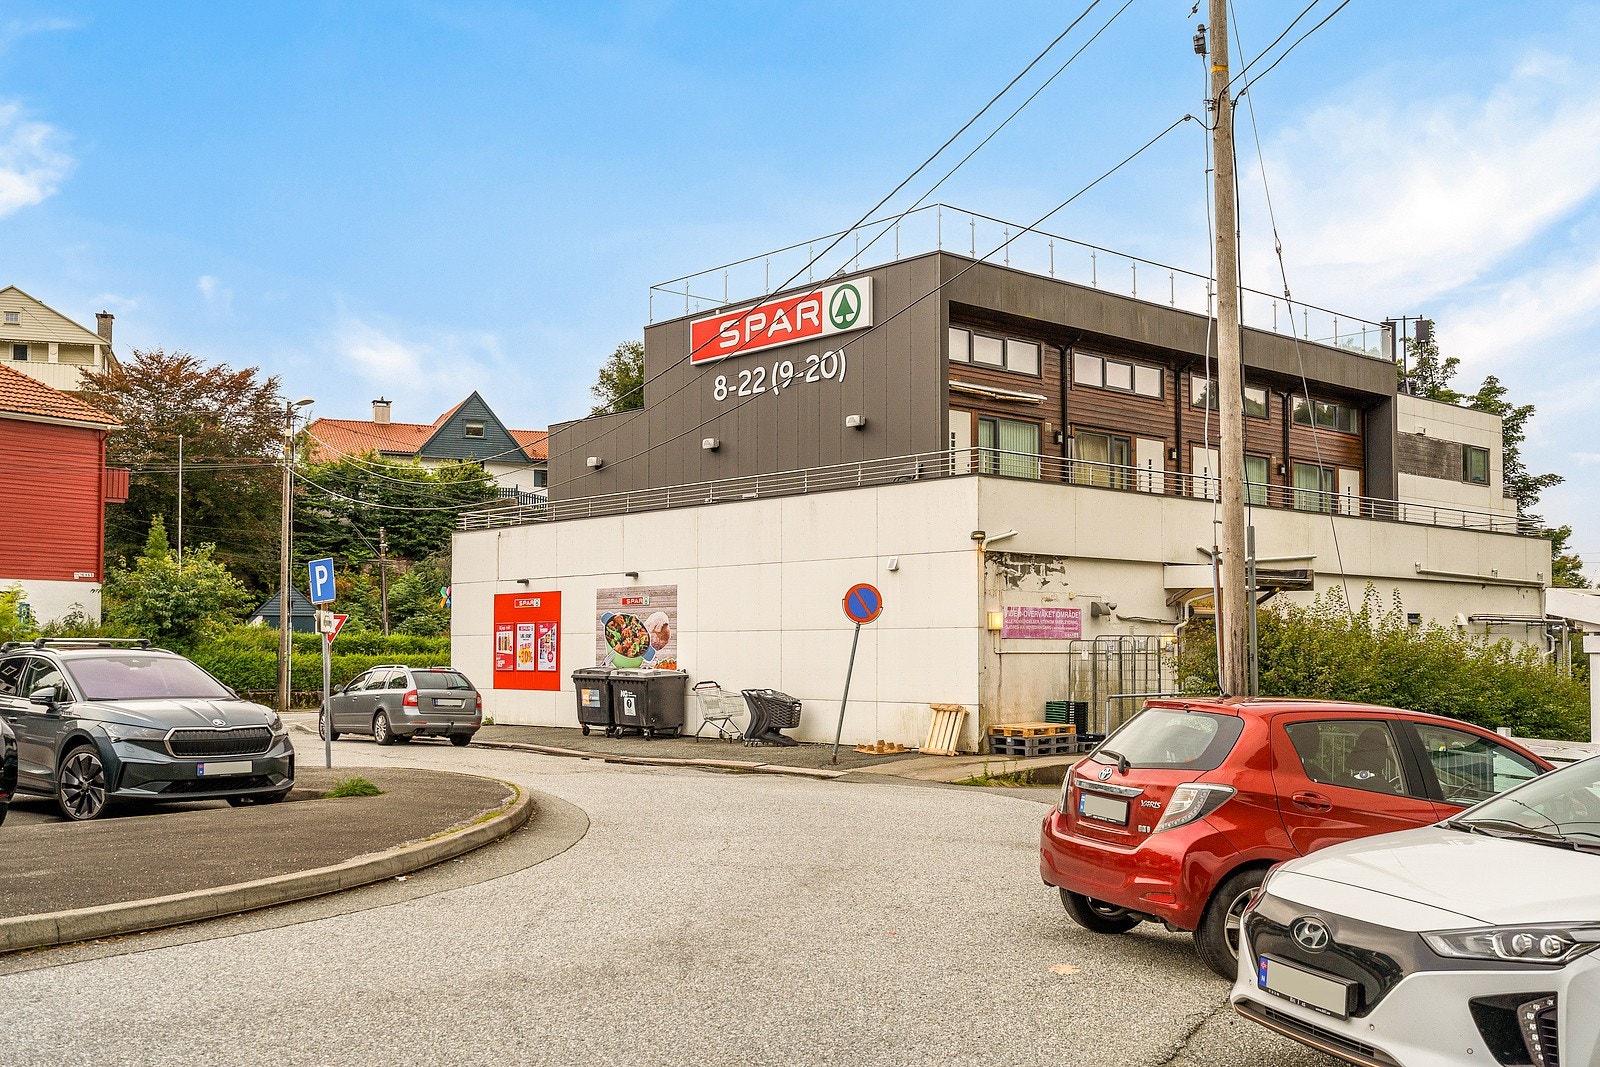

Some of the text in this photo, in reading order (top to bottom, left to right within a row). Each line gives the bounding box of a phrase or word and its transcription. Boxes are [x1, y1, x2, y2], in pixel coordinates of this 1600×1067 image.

[719, 299, 820, 348] SPAR
[713, 349, 846, 401] 8-22 (9-20)
[315, 565, 328, 597] P
[1004, 608, 1055, 618] DEO-OVERVÅKET
[1140, 799, 1161, 809] YARIS
